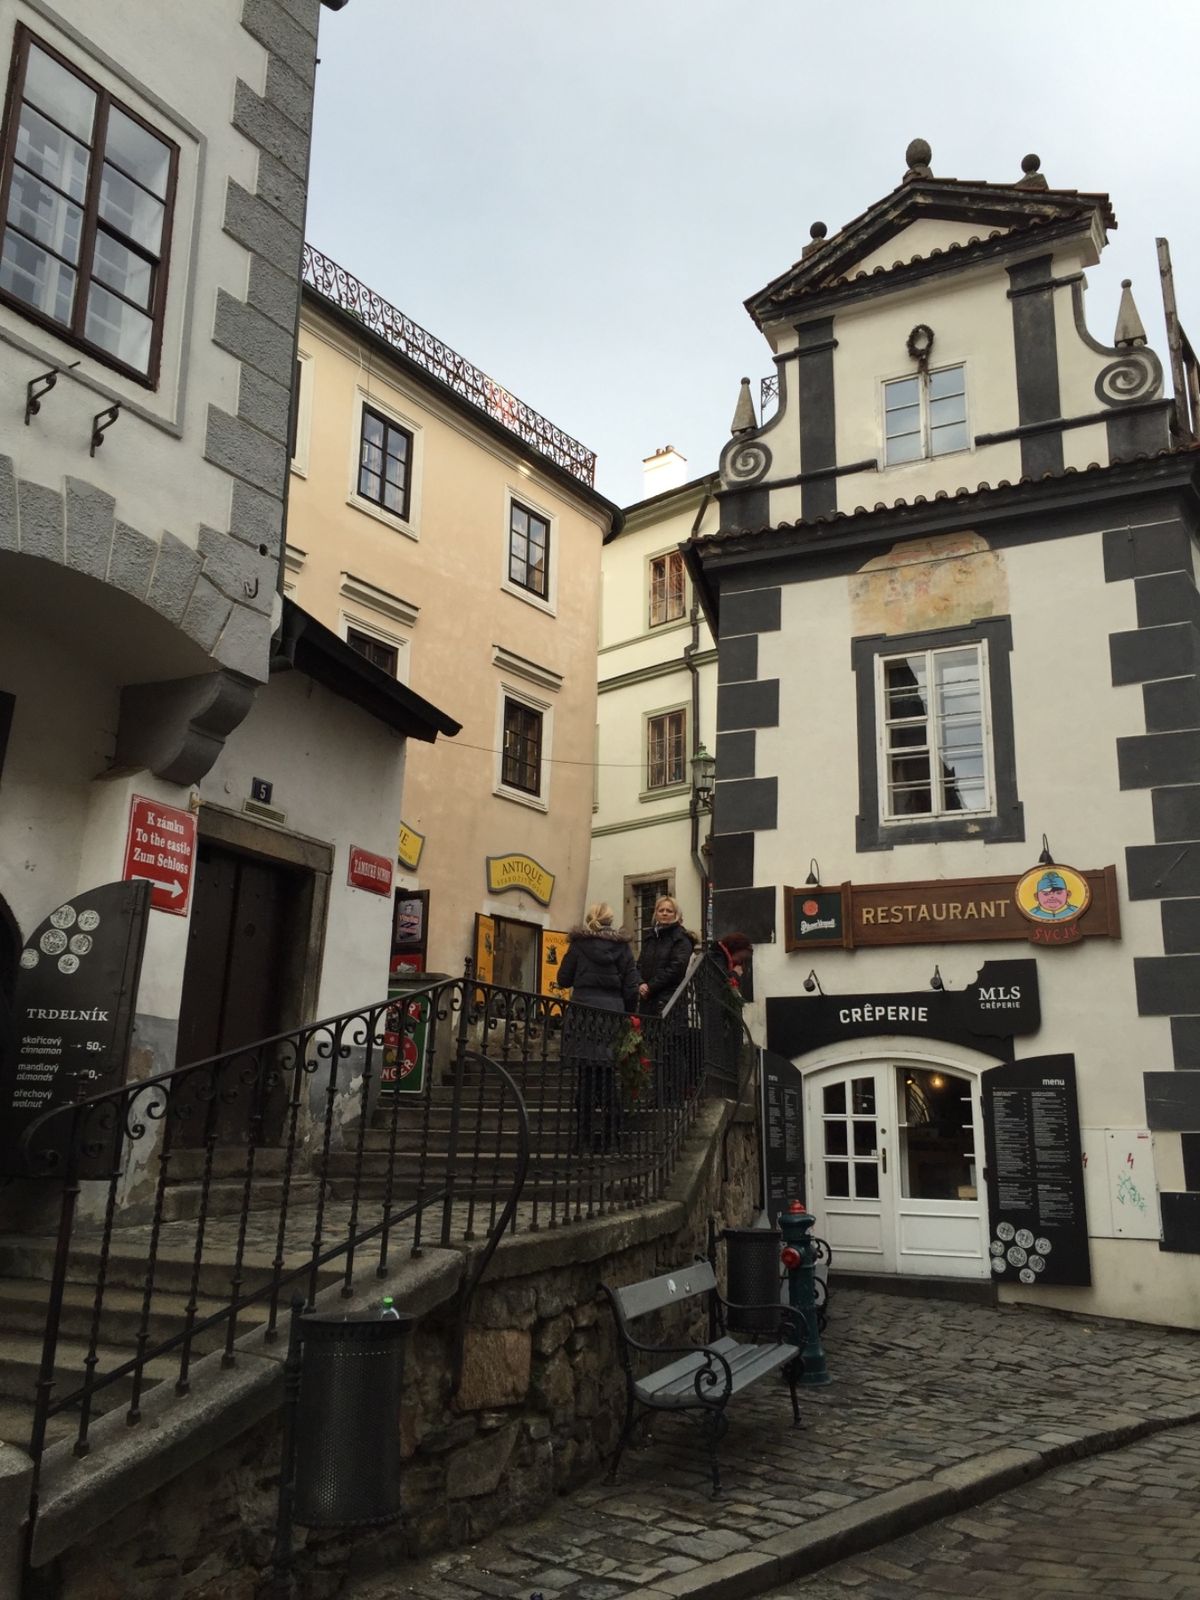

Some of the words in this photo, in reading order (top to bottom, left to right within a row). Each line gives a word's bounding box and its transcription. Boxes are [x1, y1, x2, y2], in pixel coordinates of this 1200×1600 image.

[259, 784, 266, 799] 5
[146, 811, 155, 824] K
[156, 815, 185, 835] zámku
[135, 828, 148, 843] To
[150, 832, 166, 848] the
[166, 840, 191, 856] castle
[133, 848, 155, 865] Zum
[157, 854, 189, 874] Schloss
[502, 861, 544, 885] ANTIQUE
[861, 900, 1010, 925] RESTAURANT
[978, 985, 1021, 1001] MLS
[26, 1006, 109, 1021] TRDELNÍK
[839, 1003, 928, 1024] CRÊPERIE
[980, 1001, 1021, 1010] CRÊPERIE
[1042, 1078, 1065, 1086] menu
